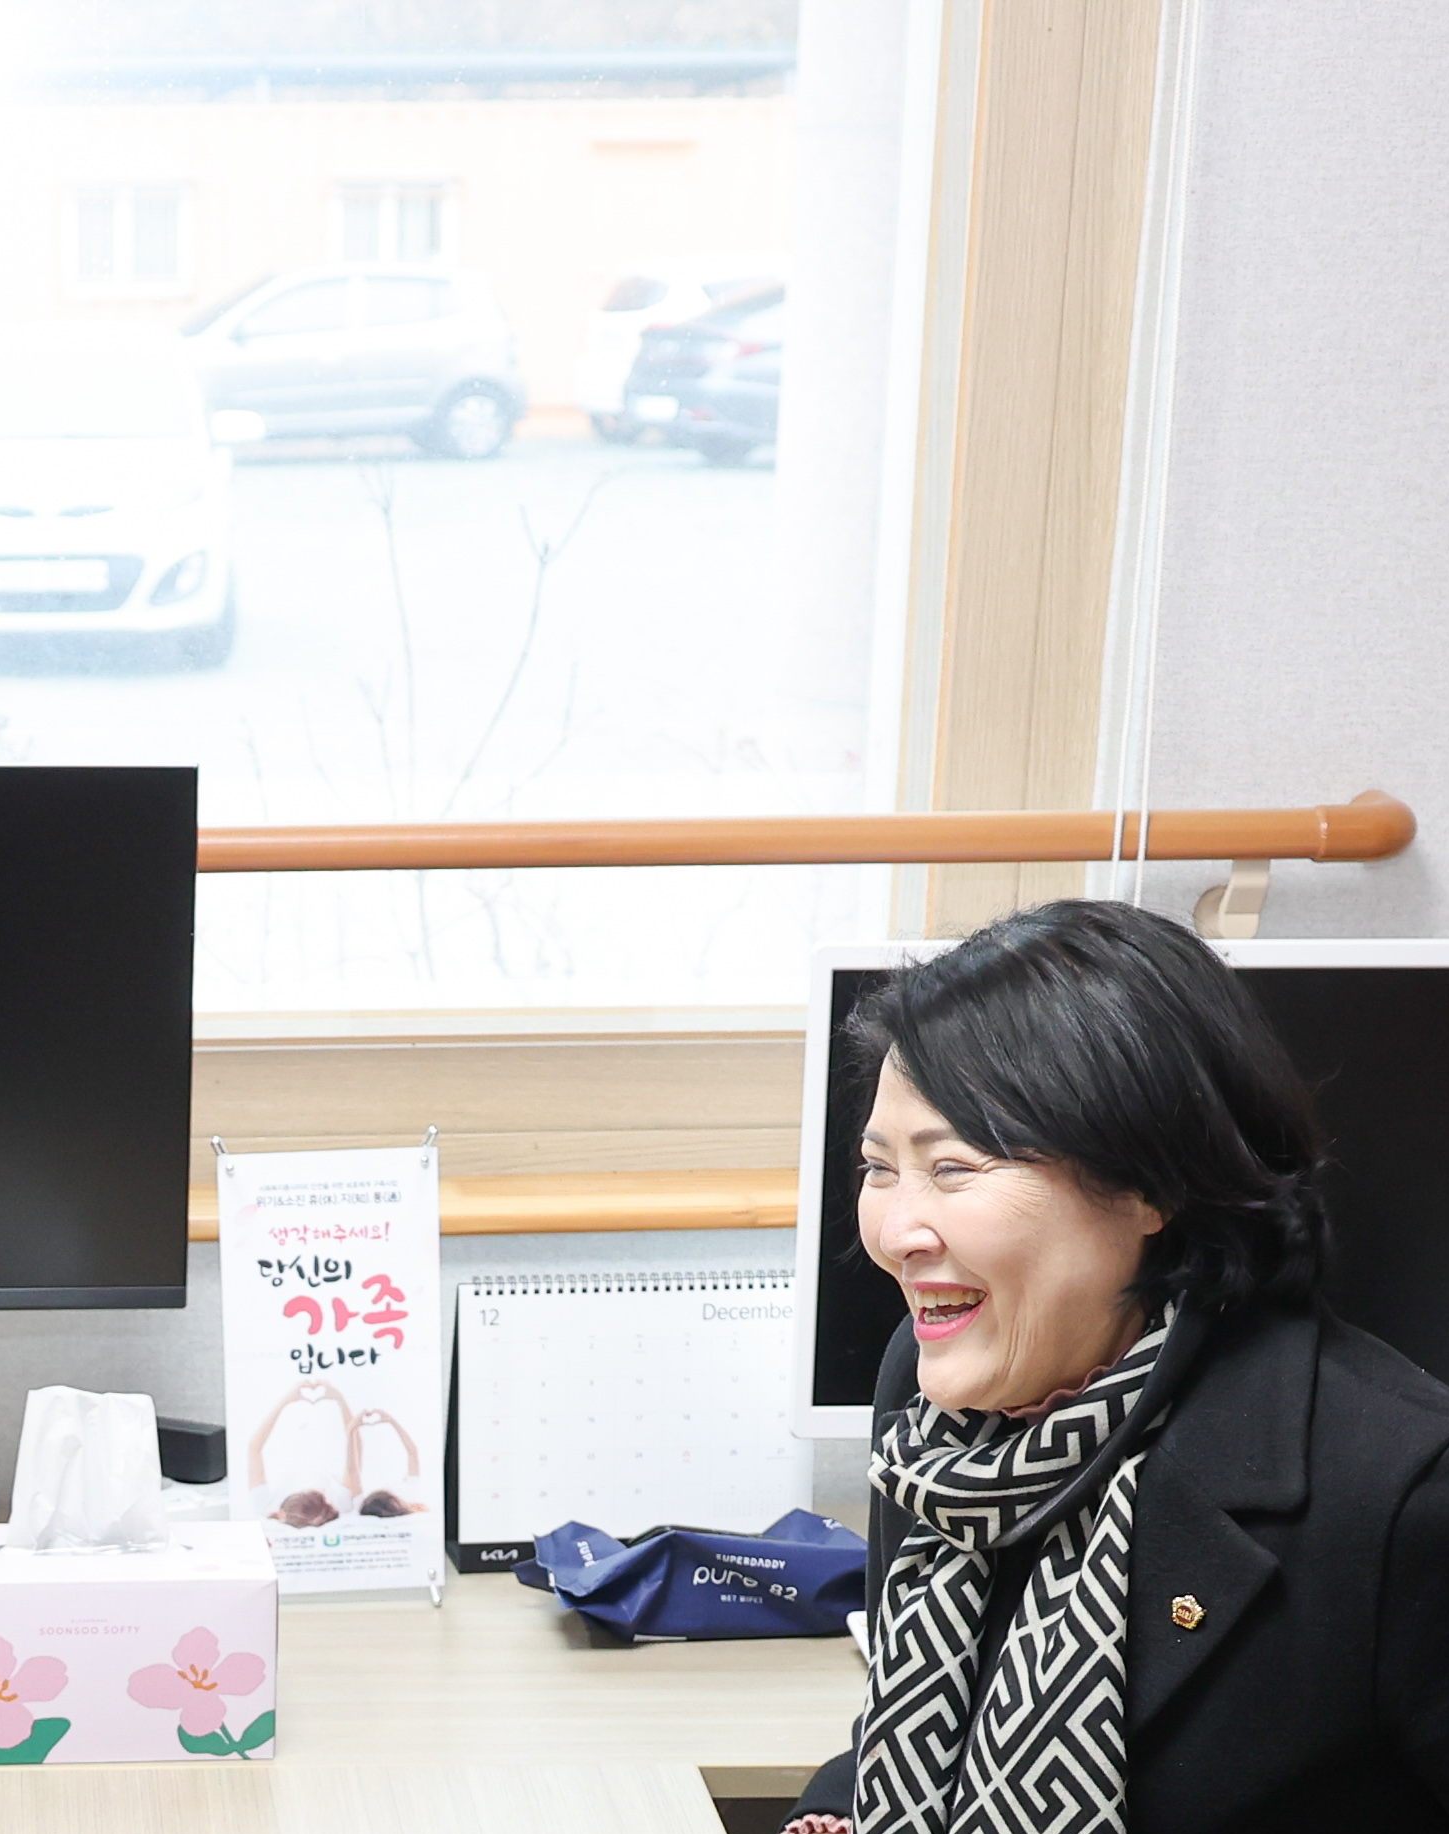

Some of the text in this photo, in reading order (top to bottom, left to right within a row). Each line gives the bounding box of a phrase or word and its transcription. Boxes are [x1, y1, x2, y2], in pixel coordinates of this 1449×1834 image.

[268, 1221, 390, 1246] 생각해주세요!
[257, 1255, 352, 1288] 당신의
[283, 1274, 409, 1350] 가족
[479, 1308, 500, 1327] 12
[702, 1301, 794, 1320] Decembe
[290, 1343, 382, 1374] 입니다
[692, 1566, 798, 1602] pure 82
[39, 1625, 140, 1636] SOONSOO SOFTY
